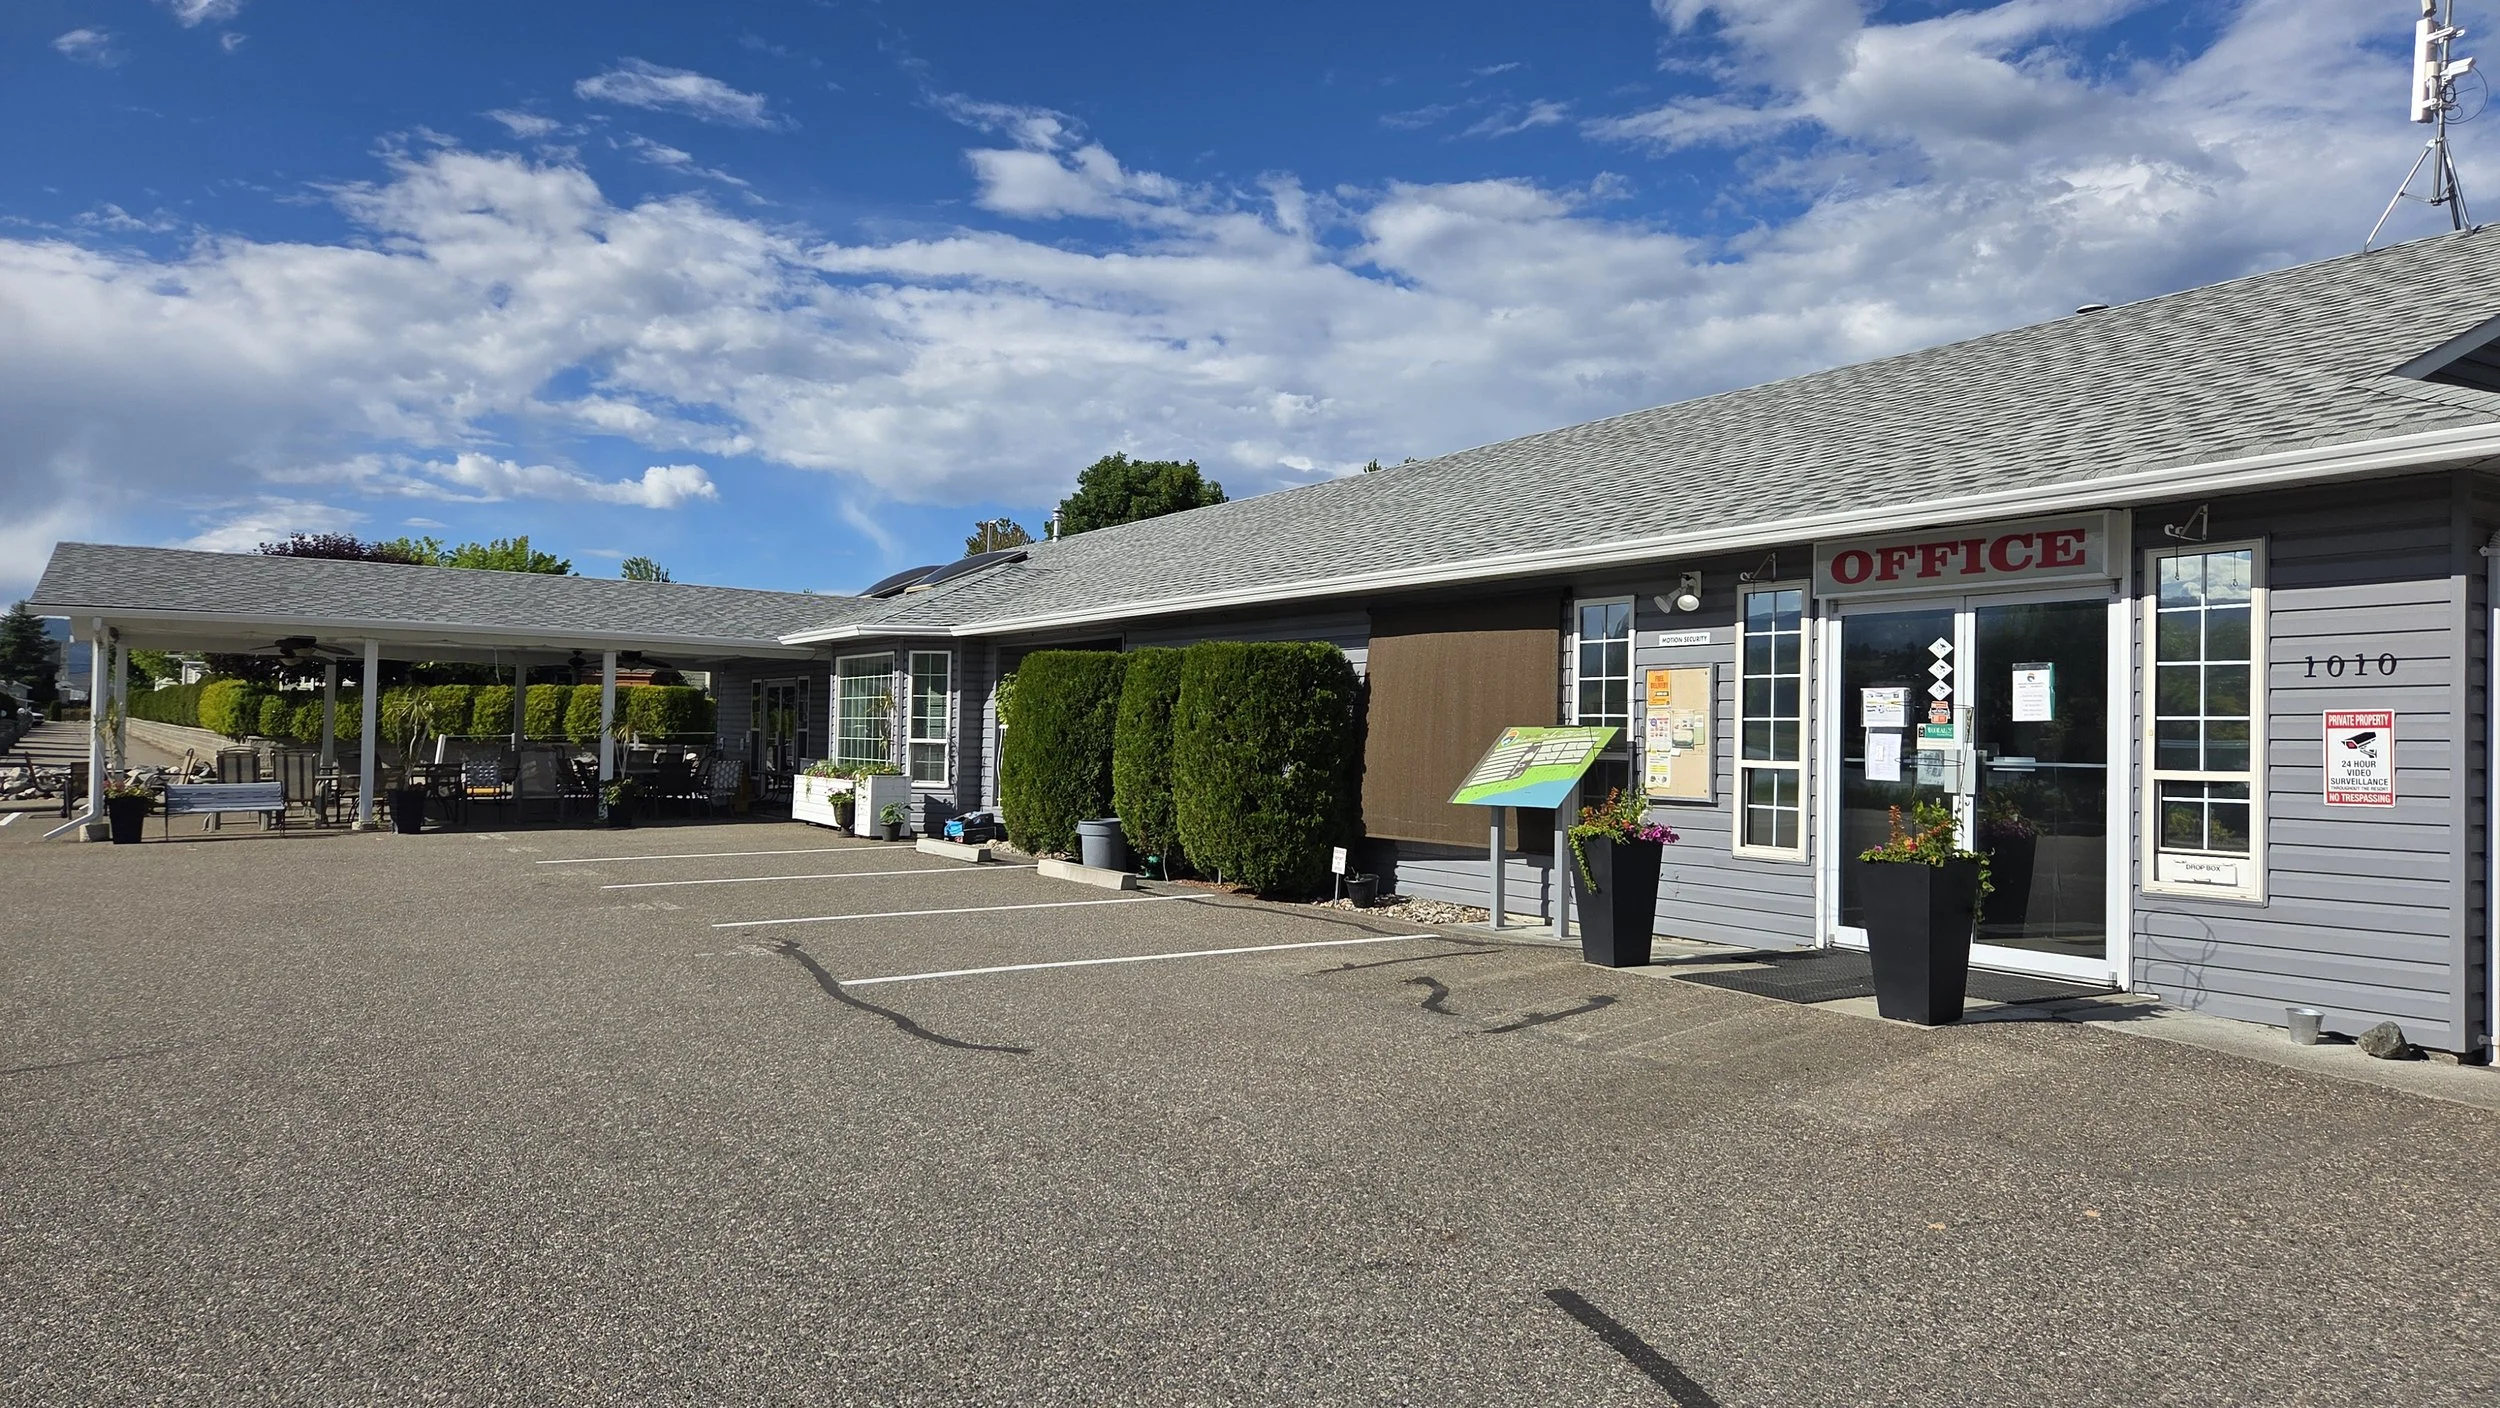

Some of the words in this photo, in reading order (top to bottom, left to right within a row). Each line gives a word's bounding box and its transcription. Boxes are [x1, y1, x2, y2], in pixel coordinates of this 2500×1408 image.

[1831, 528, 2085, 585] OFFICE
[1683, 635, 1708, 643] SECURITY
[2304, 653, 2397, 678] 1010
[2328, 714, 2354, 726] PRIVATE
[2355, 713, 2389, 726] PROPERTY
[2341, 760, 2352, 768] 24
[2353, 760, 2377, 768] HOUR
[2346, 769, 2372, 777] VIDEO
[2330, 778, 2389, 786] SURVEILLANCE
[2329, 793, 2340, 801] NO
[2341, 793, 2391, 803] TRESPASSING
